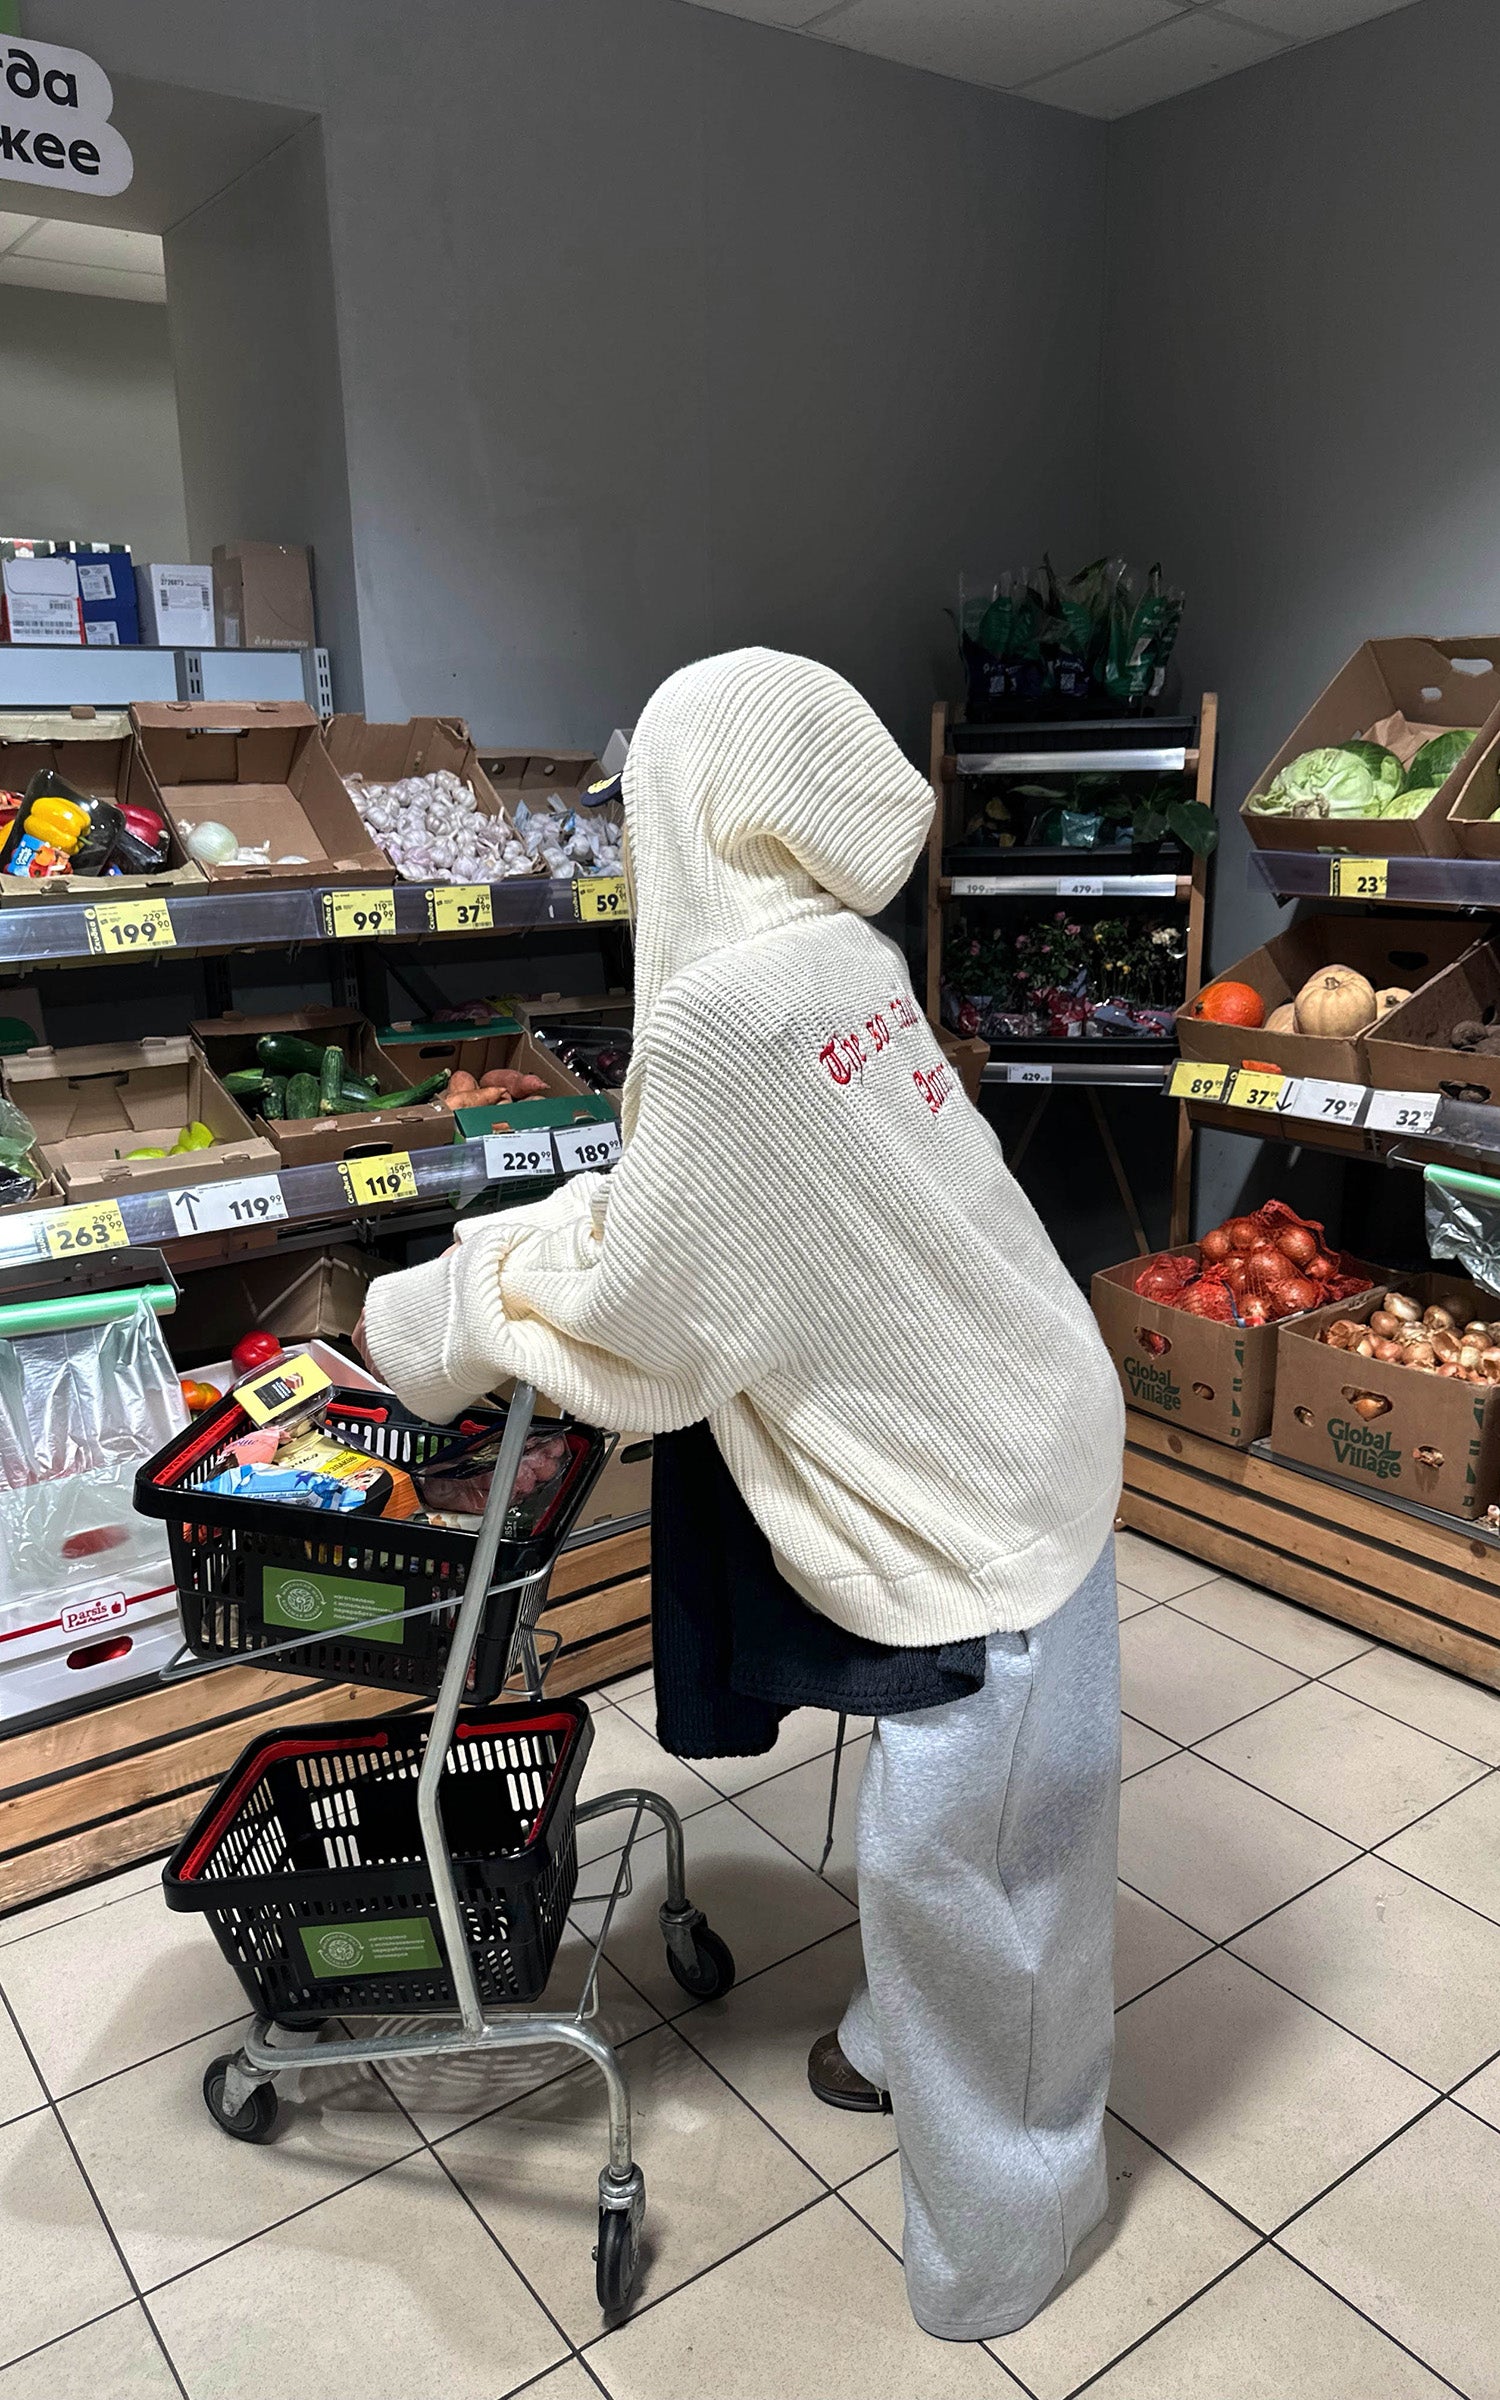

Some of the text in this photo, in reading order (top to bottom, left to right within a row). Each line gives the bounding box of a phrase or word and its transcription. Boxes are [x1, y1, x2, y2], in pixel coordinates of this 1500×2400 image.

[0, 48, 79, 109] да
[967, 884, 985, 894] 199
[1071, 884, 1092, 894] 479
[1357, 876, 1378, 893] 23
[374, 903, 388, 912] 119
[596, 893, 619, 912] 59
[142, 913, 161, 923] 229
[353, 910, 394, 931] 99 99
[456, 905, 480, 924] 37
[89, 920, 103, 953] Скидка
[110, 919, 170, 946] 199 90
[1022, 1072, 1041, 1081] 429
[1190, 1078, 1214, 1095] 89
[1246, 1088, 1270, 1106] 37
[1322, 1097, 1347, 1115] 79
[1395, 1109, 1422, 1127] 32
[502, 1151, 551, 1171] 229 99
[574, 1139, 619, 1164] 189 99
[389, 1164, 405, 1174] 159
[342, 1175, 355, 1204] Скидка
[365, 1171, 413, 1196] 119 99
[228, 1194, 282, 1221] 119 99
[92, 1213, 113, 1225] 299
[56, 1219, 122, 1251] 263 99
[1123, 1356, 1172, 1388] Global
[1128, 1376, 1182, 1411] Village
[1327, 1417, 1393, 1451] Global
[1332, 1439, 1401, 1479] Village
[67, 1601, 108, 1628] Parsis
